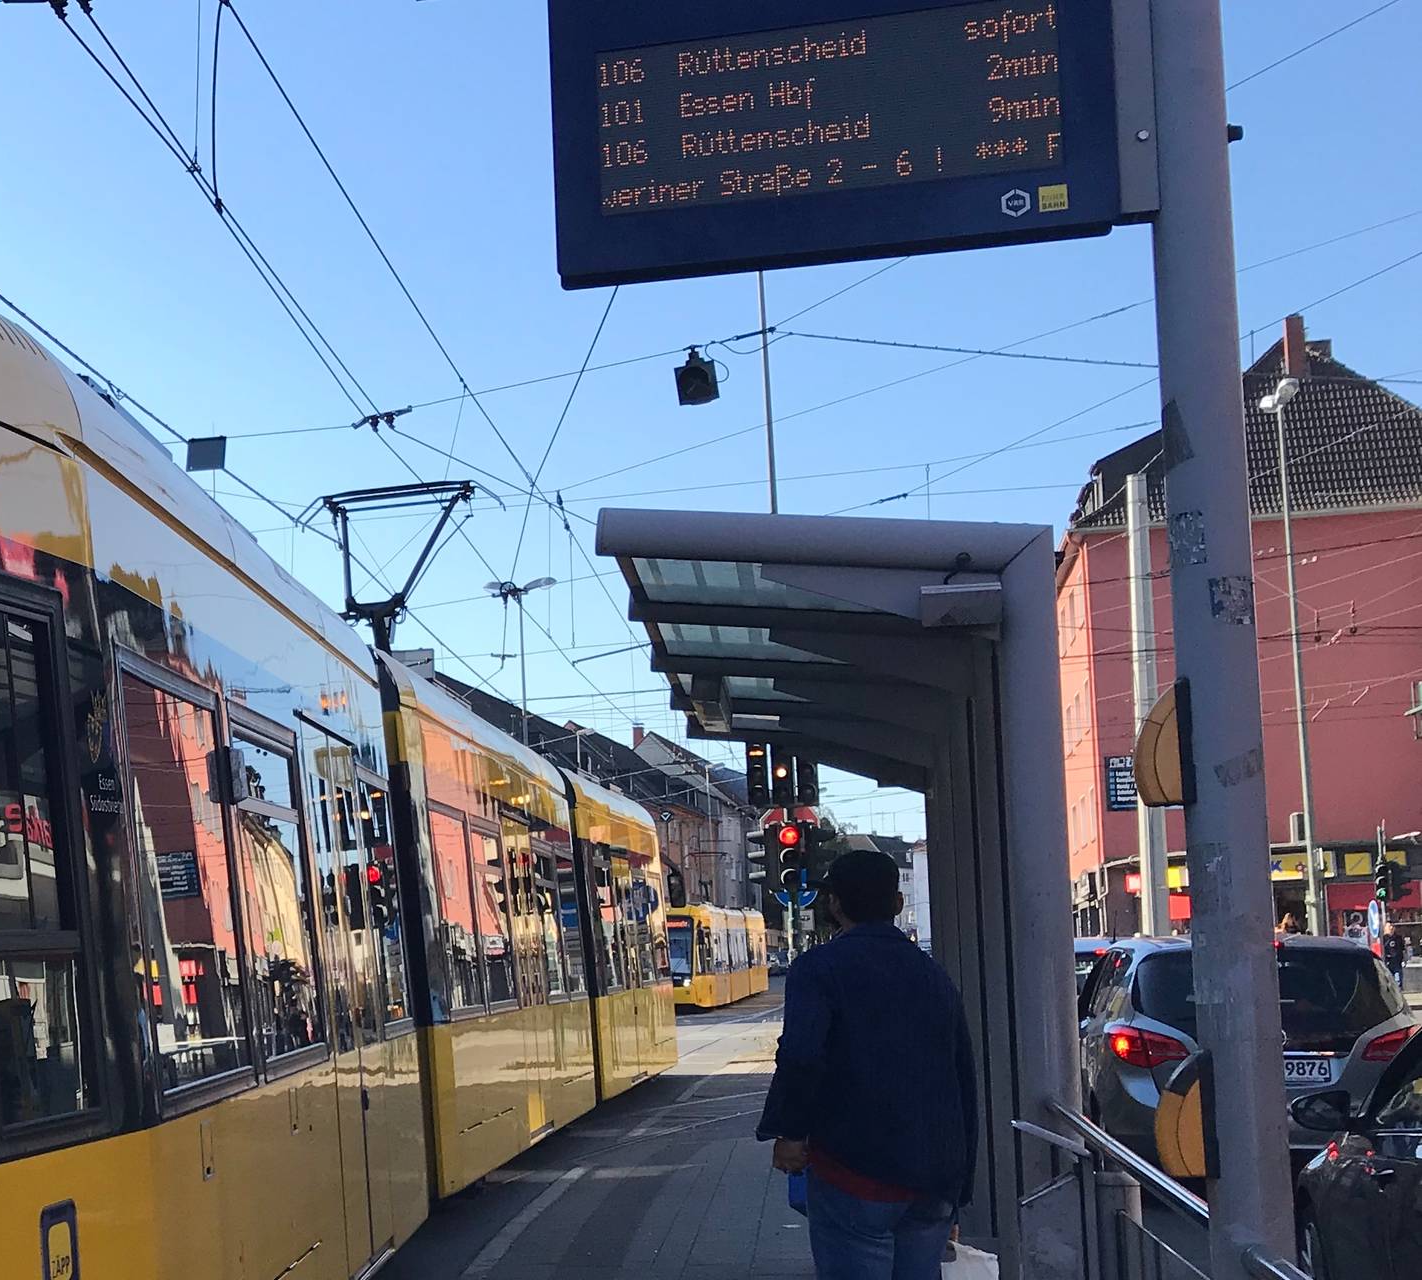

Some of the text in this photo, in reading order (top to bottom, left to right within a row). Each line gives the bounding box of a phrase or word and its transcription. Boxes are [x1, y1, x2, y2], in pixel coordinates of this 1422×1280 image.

[600, 4, 1057, 87] 106 Rüttenscheid sofort
[602, 49, 1059, 127] 101 Essen Hbf 2min
[602, 92, 1061, 168] 106 Rüttenscheid 9min
[720, 163, 812, 196] Straße
[827, 158, 843, 184] 2
[896, 149, 913, 177] 6
[1041, 200, 1066, 210] BAHN
[98, 773, 115, 790] Essen
[1285, 1062, 1328, 1077] 9876
